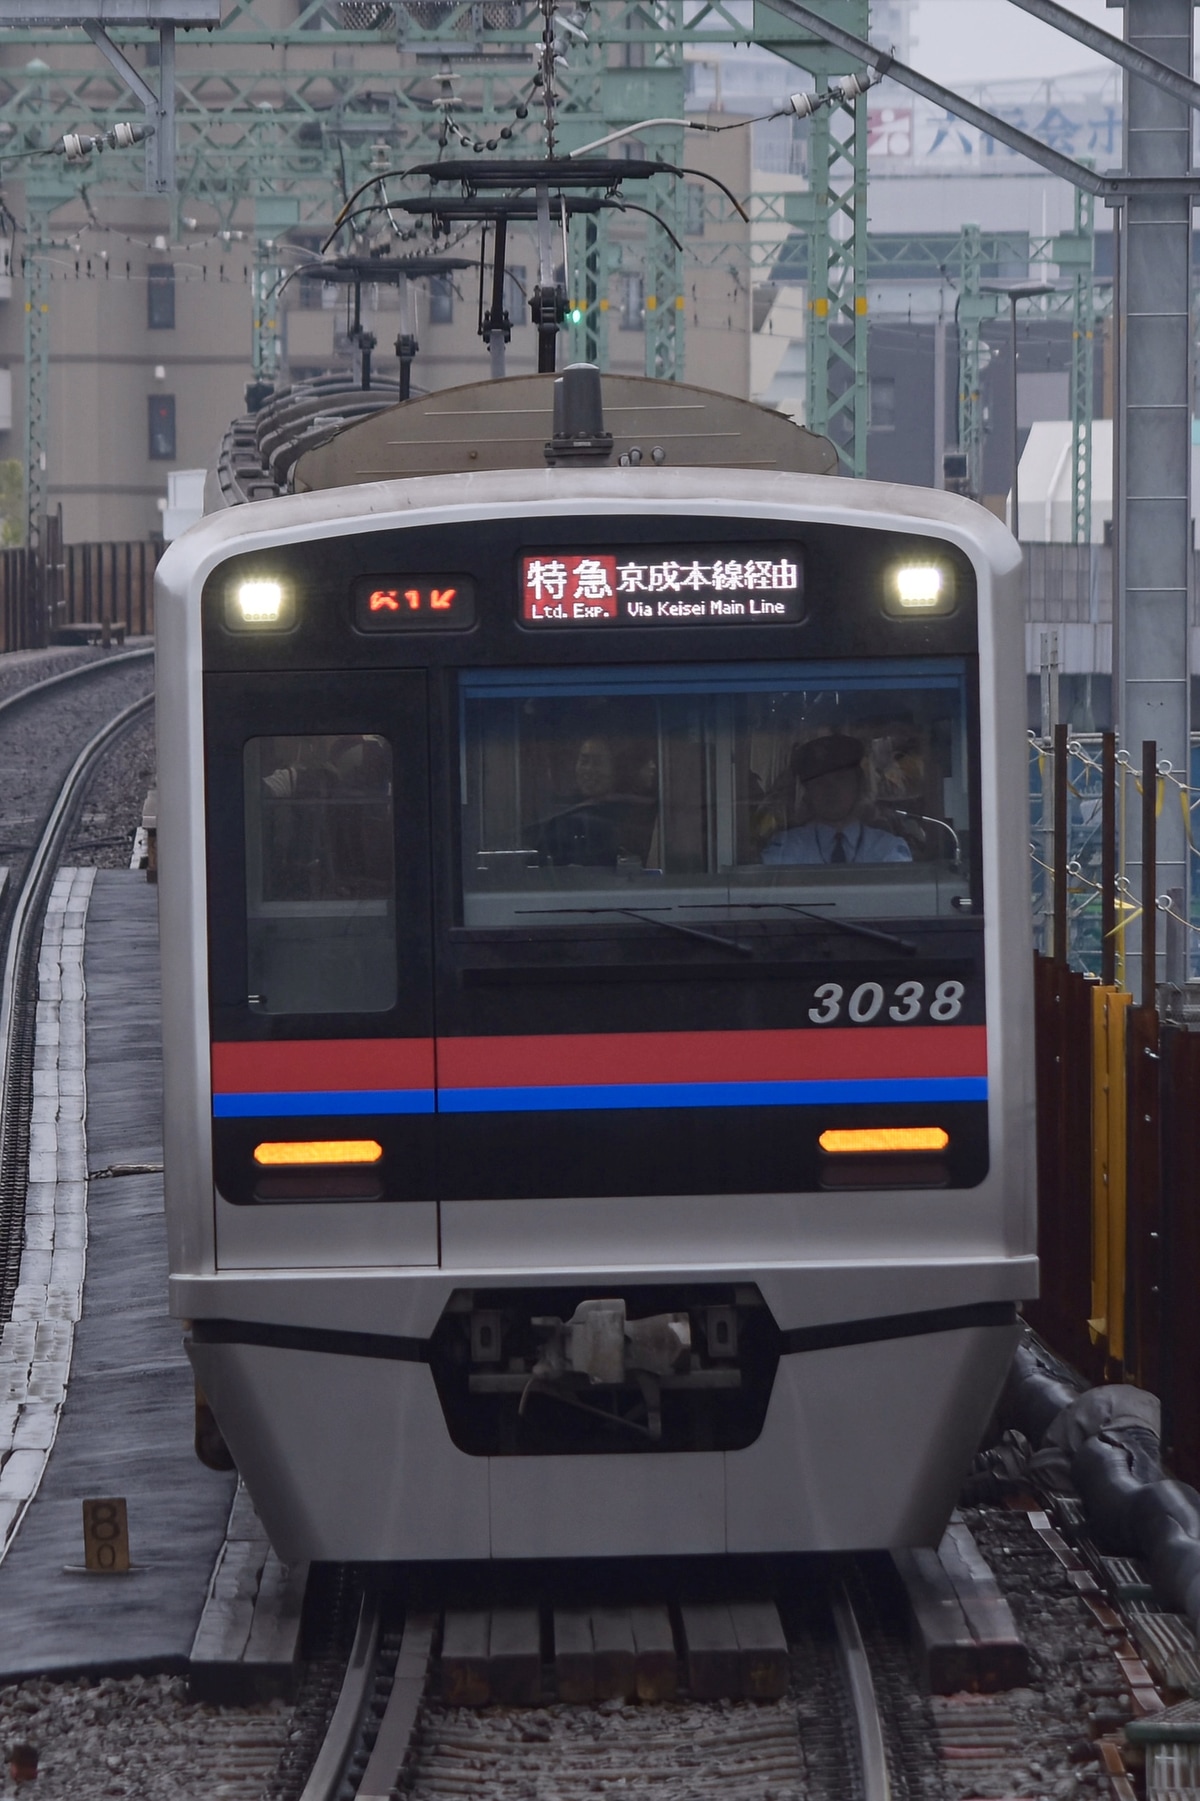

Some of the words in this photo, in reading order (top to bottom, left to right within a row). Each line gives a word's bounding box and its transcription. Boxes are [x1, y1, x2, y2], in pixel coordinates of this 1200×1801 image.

[526, 559, 613, 600] 特急
[616, 559, 797, 592] 京成本線経由
[532, 603, 568, 619] Ltd.
[573, 602, 610, 618] Exp.
[627, 601, 653, 617] Via
[657, 600, 706, 617] Keisei
[710, 599, 745, 615] Main
[749, 598, 785, 614] Line
[808, 980, 965, 1024] 3038
[91, 1503, 120, 1570] 80
